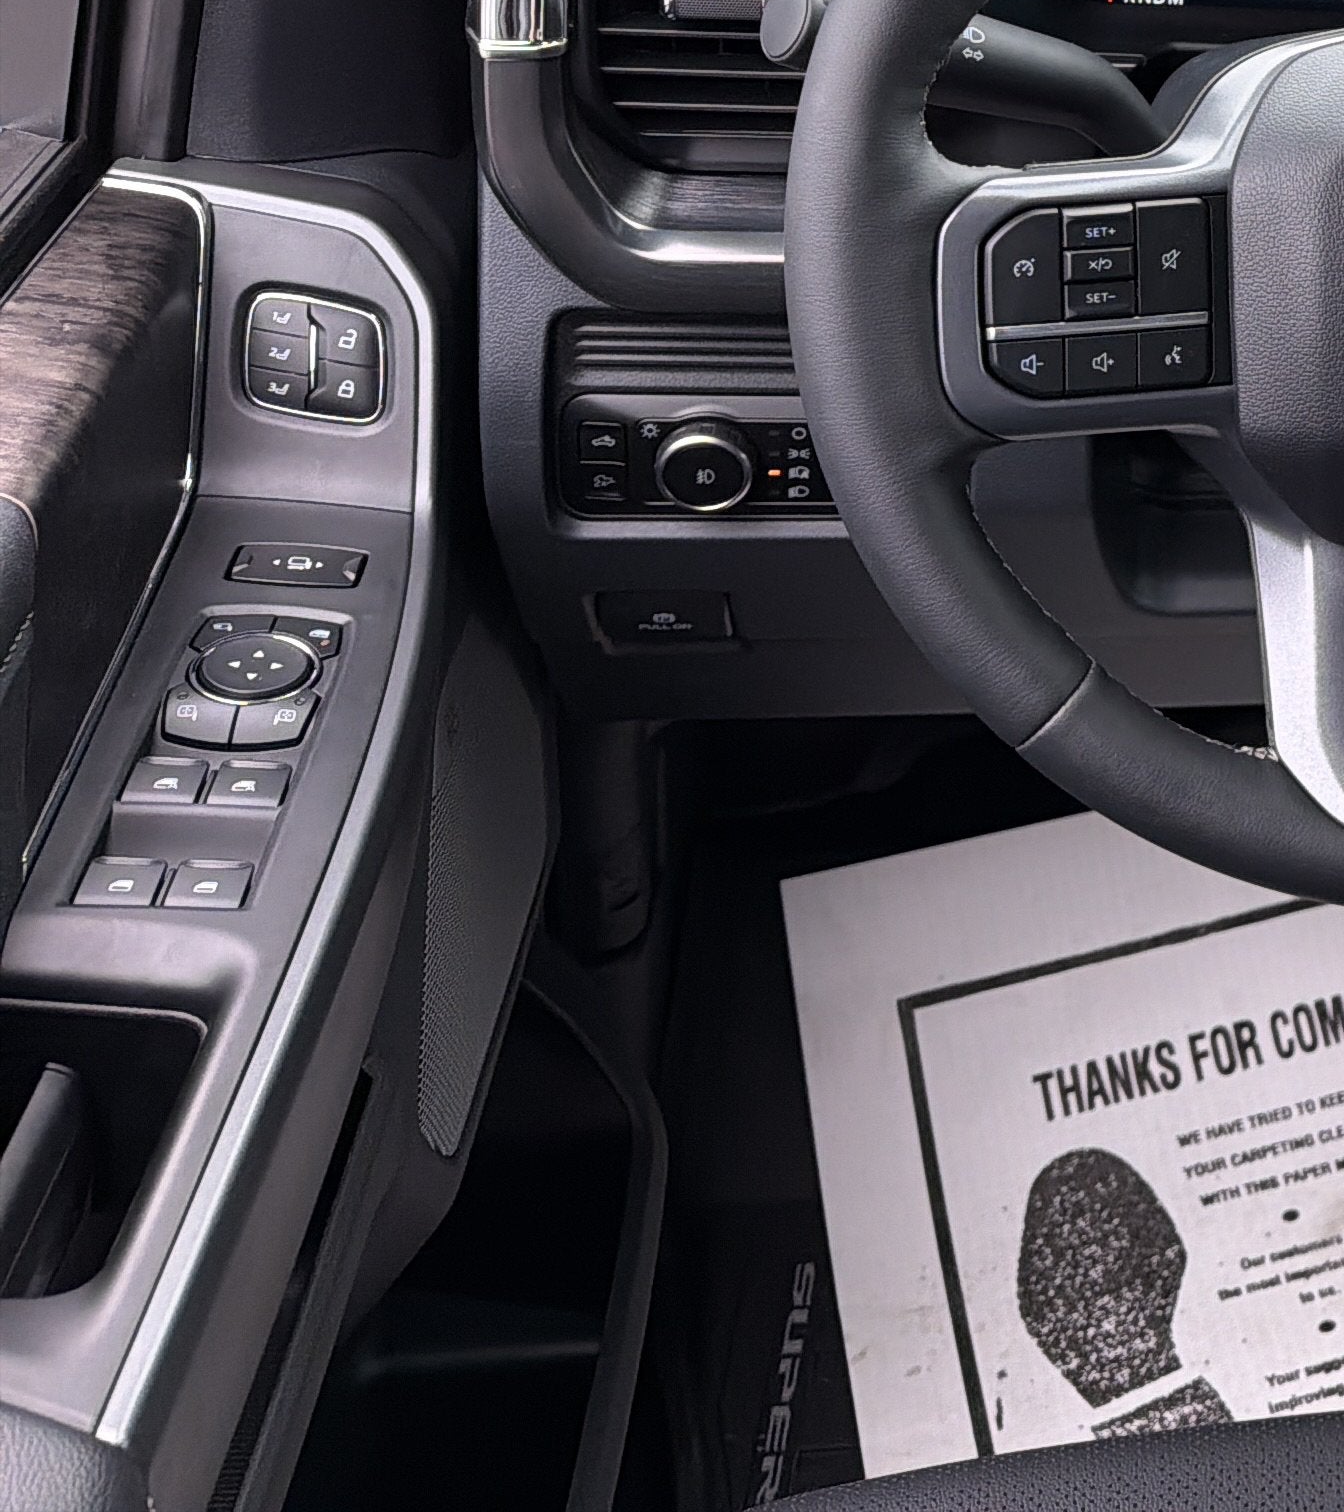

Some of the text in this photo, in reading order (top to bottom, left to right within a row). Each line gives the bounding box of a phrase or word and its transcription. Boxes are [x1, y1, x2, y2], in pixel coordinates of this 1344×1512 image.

[1085, 226, 1116, 239] SET+
[1032, 1040, 1183, 1122] THANKS
[1188, 1020, 1263, 1081] FOR
[1176, 1129, 1200, 1147] WE
[1205, 1118, 1245, 1140] HAVE
[1248, 1106, 1293, 1129] TRIED
[1295, 1099, 1316, 1116] TO
[1183, 1156, 1227, 1180] YOUR
[1230, 1133, 1315, 1167] CARPETING
[1200, 1185, 1241, 1206] WITH
[1244, 1175, 1280, 1195] THIS
[1283, 1161, 1332, 1186] PAPER
[1240, 1255, 1266, 1270] Our
[1265, 1368, 1301, 1387] Your
